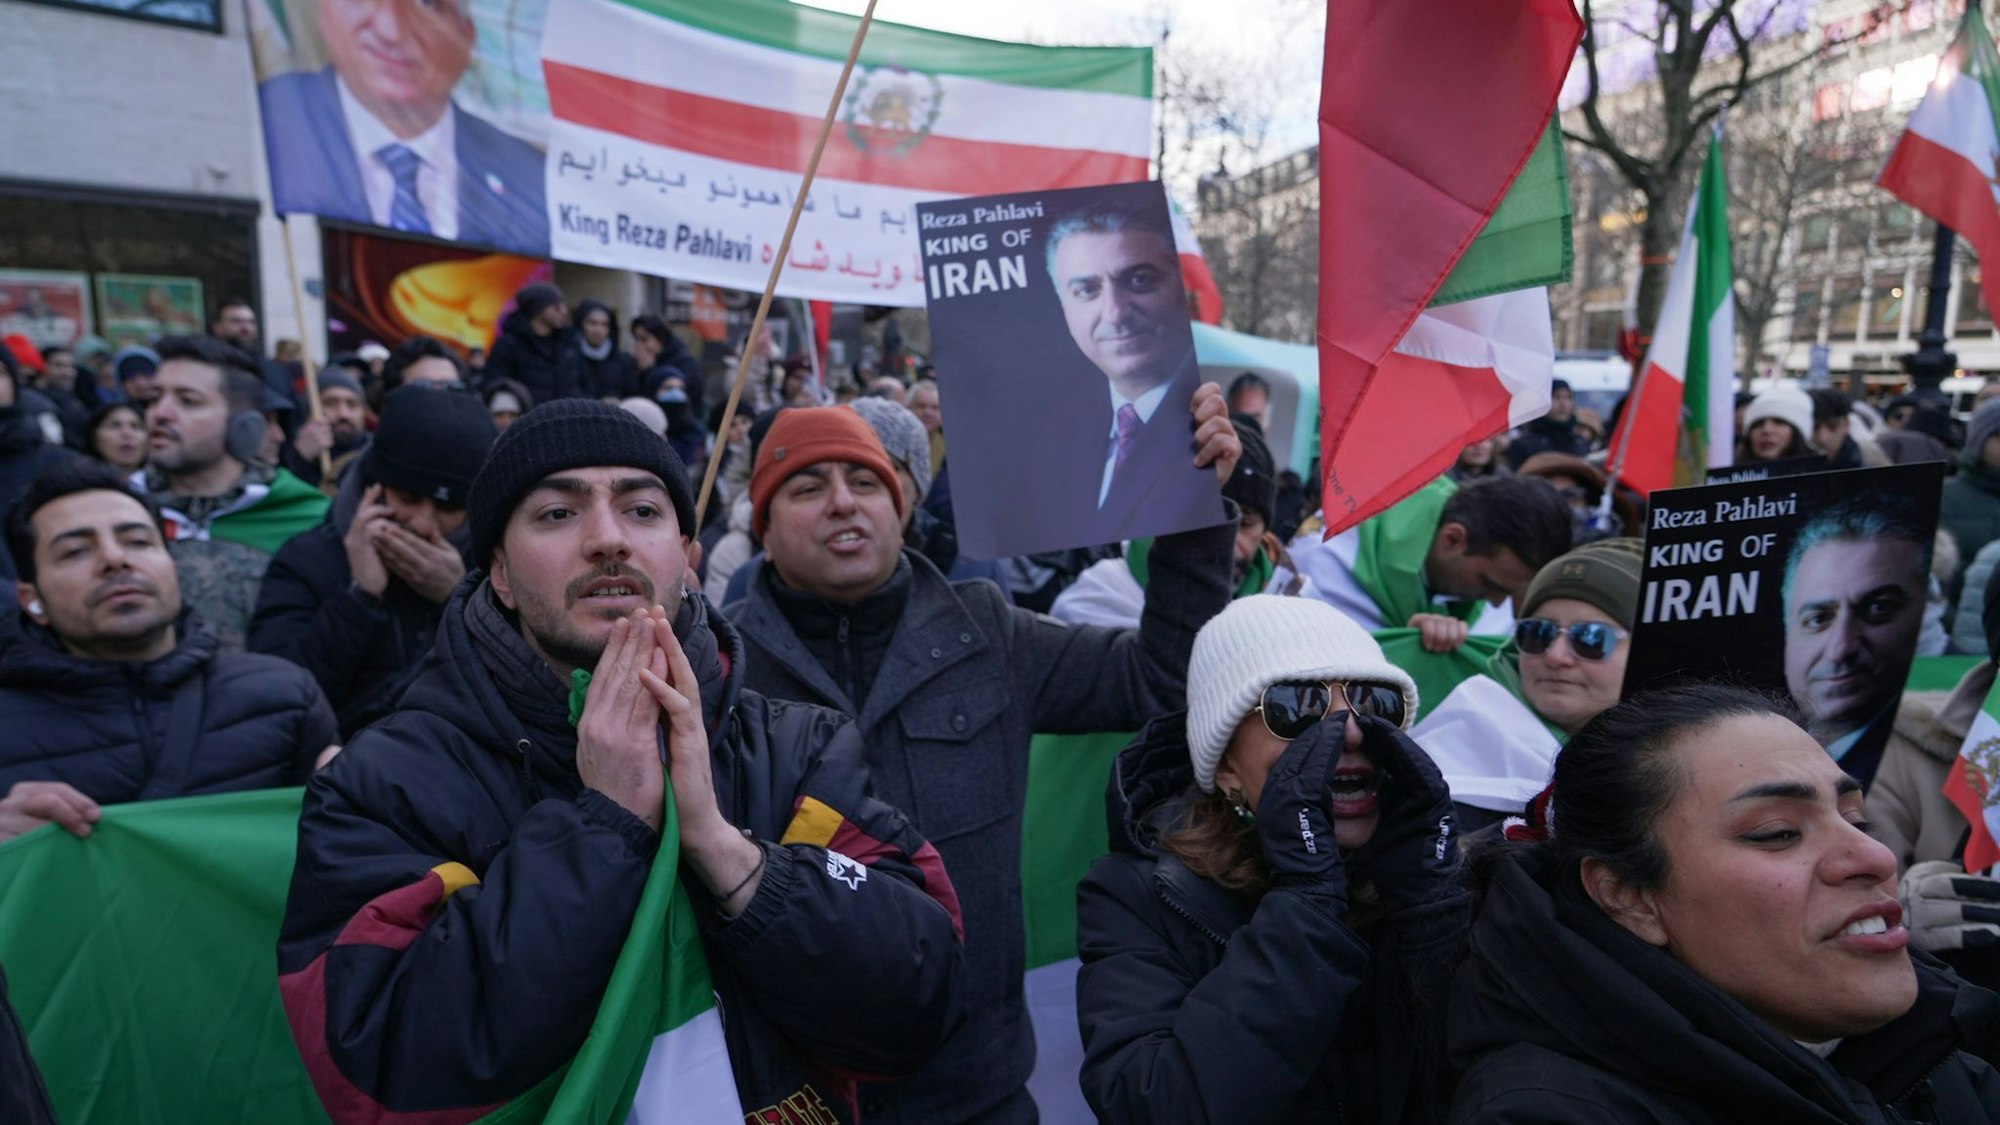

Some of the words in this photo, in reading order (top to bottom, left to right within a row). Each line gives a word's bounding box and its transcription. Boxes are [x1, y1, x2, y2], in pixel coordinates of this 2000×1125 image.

[559, 203, 610, 245] King
[617, 213, 667, 249] Reza
[675, 223, 752, 263] Pahlavi
[922, 212, 968, 229] Reza
[973, 201, 1044, 224] Pahlavi
[925, 233, 988, 257] KING
[1001, 228, 1032, 248] OF
[928, 254, 1028, 299] IRAN
[1651, 507, 1707, 530] Reza
[1713, 492, 1798, 523] Pahlavi
[1650, 539, 1725, 568] KING
[1740, 532, 1777, 558] OF
[1641, 570, 1760, 623] IRAN
